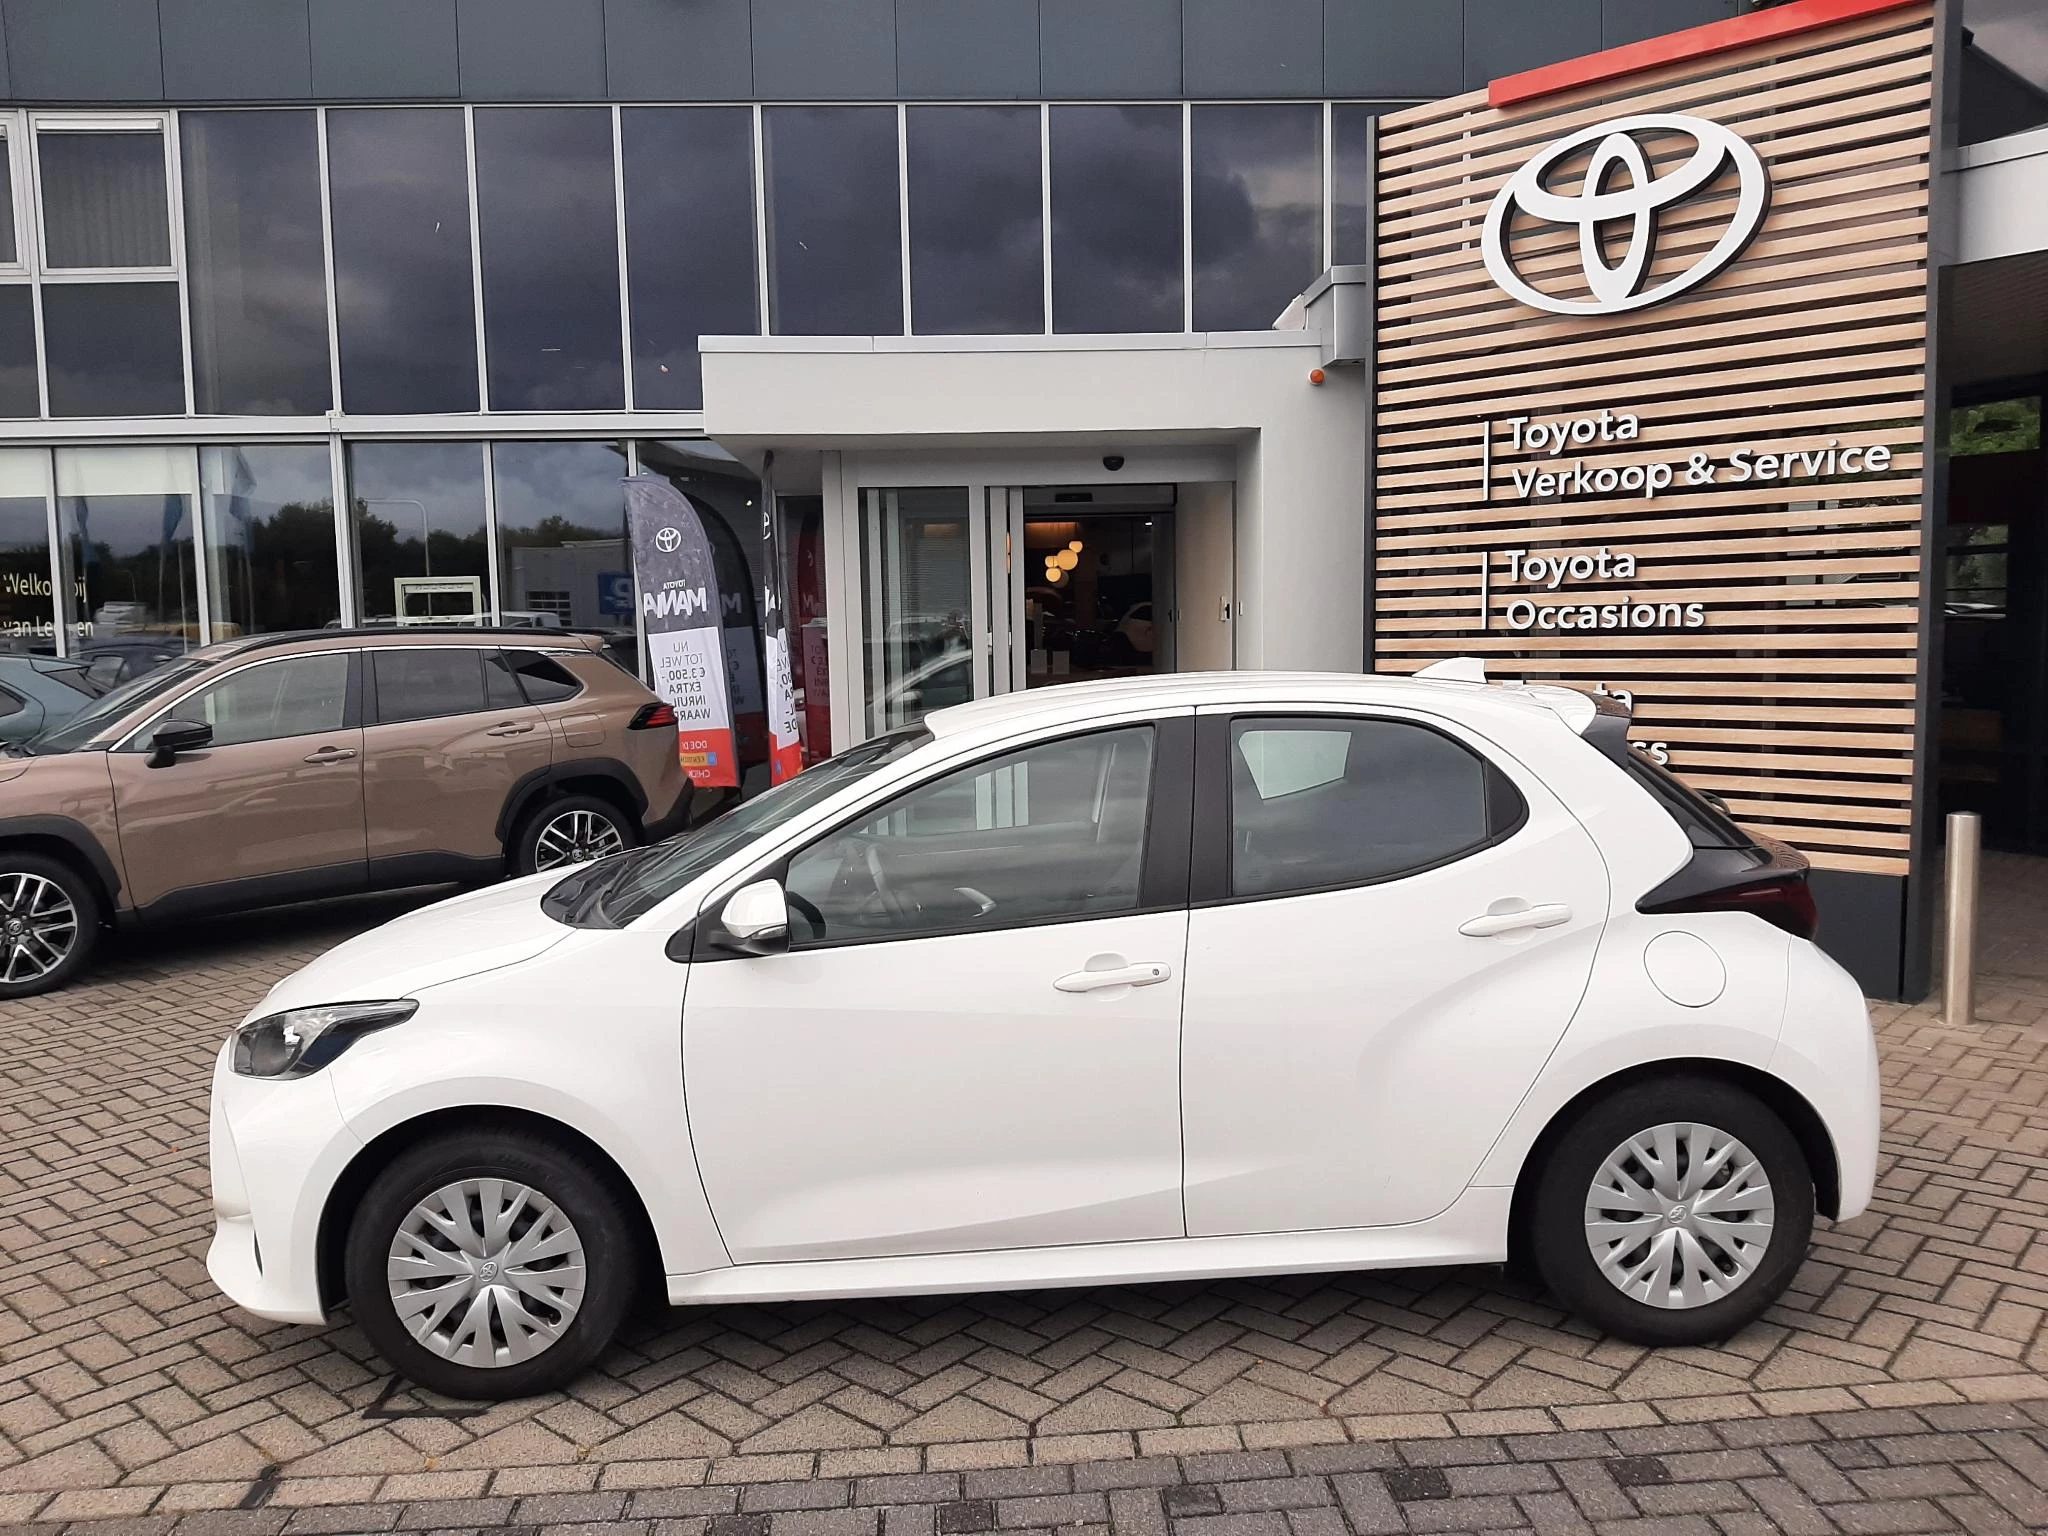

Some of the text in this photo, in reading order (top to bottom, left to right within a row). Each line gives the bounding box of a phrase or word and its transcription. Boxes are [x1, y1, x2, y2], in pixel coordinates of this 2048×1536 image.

[1506, 409, 1640, 456] Toyota
[1511, 439, 1892, 498] Verkoop & Service
[3, 572, 52, 596] Welko
[1505, 546, 1637, 589] Toyota
[1506, 596, 1706, 630] Occasions
